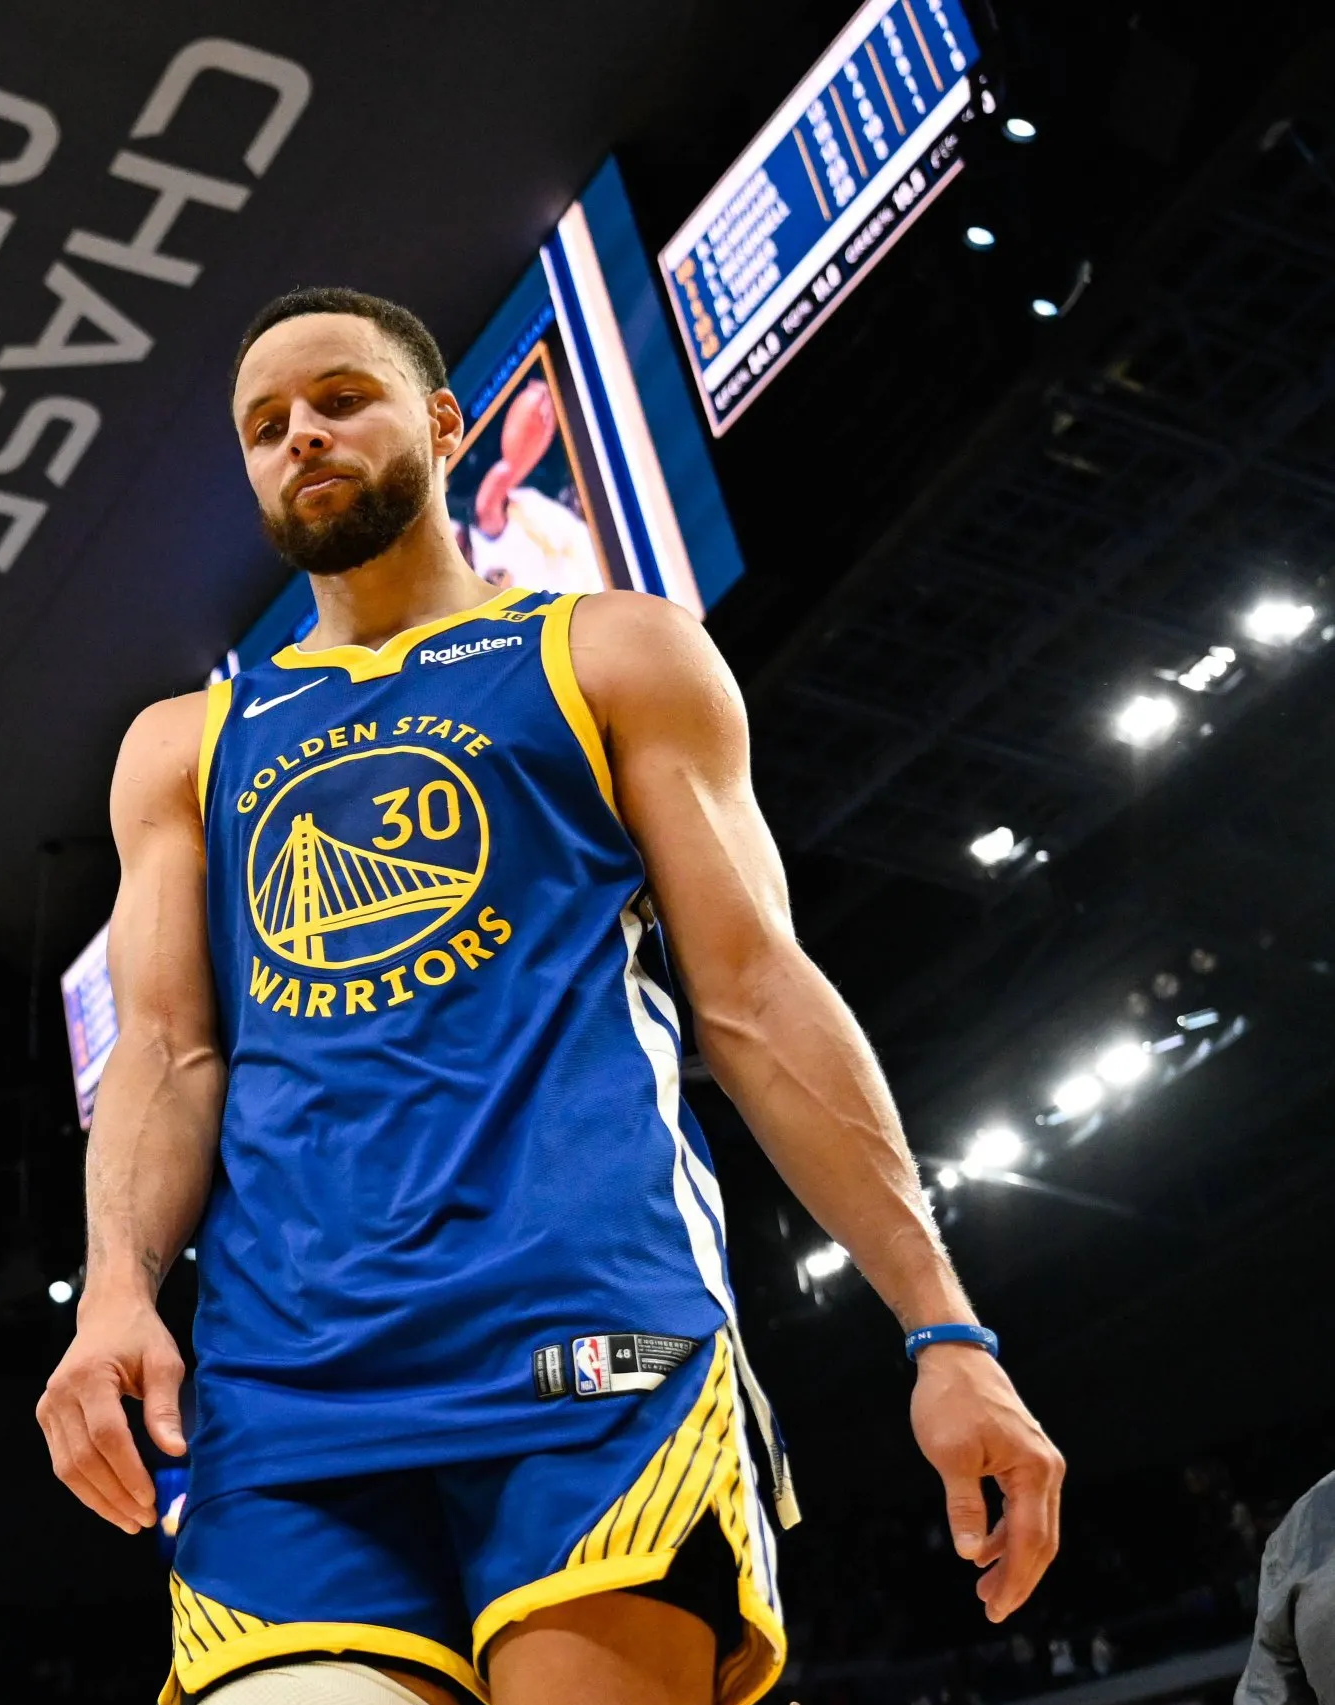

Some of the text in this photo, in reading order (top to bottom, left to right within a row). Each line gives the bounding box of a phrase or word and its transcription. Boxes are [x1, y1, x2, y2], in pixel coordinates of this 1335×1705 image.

[420, 636, 523, 665] Rakuten
[237, 715, 493, 815] GOLDEN STATE
[371, 779, 461, 851] 30
[248, 905, 513, 1018] WARRIORS
[616, 1348, 632, 1359] 48
